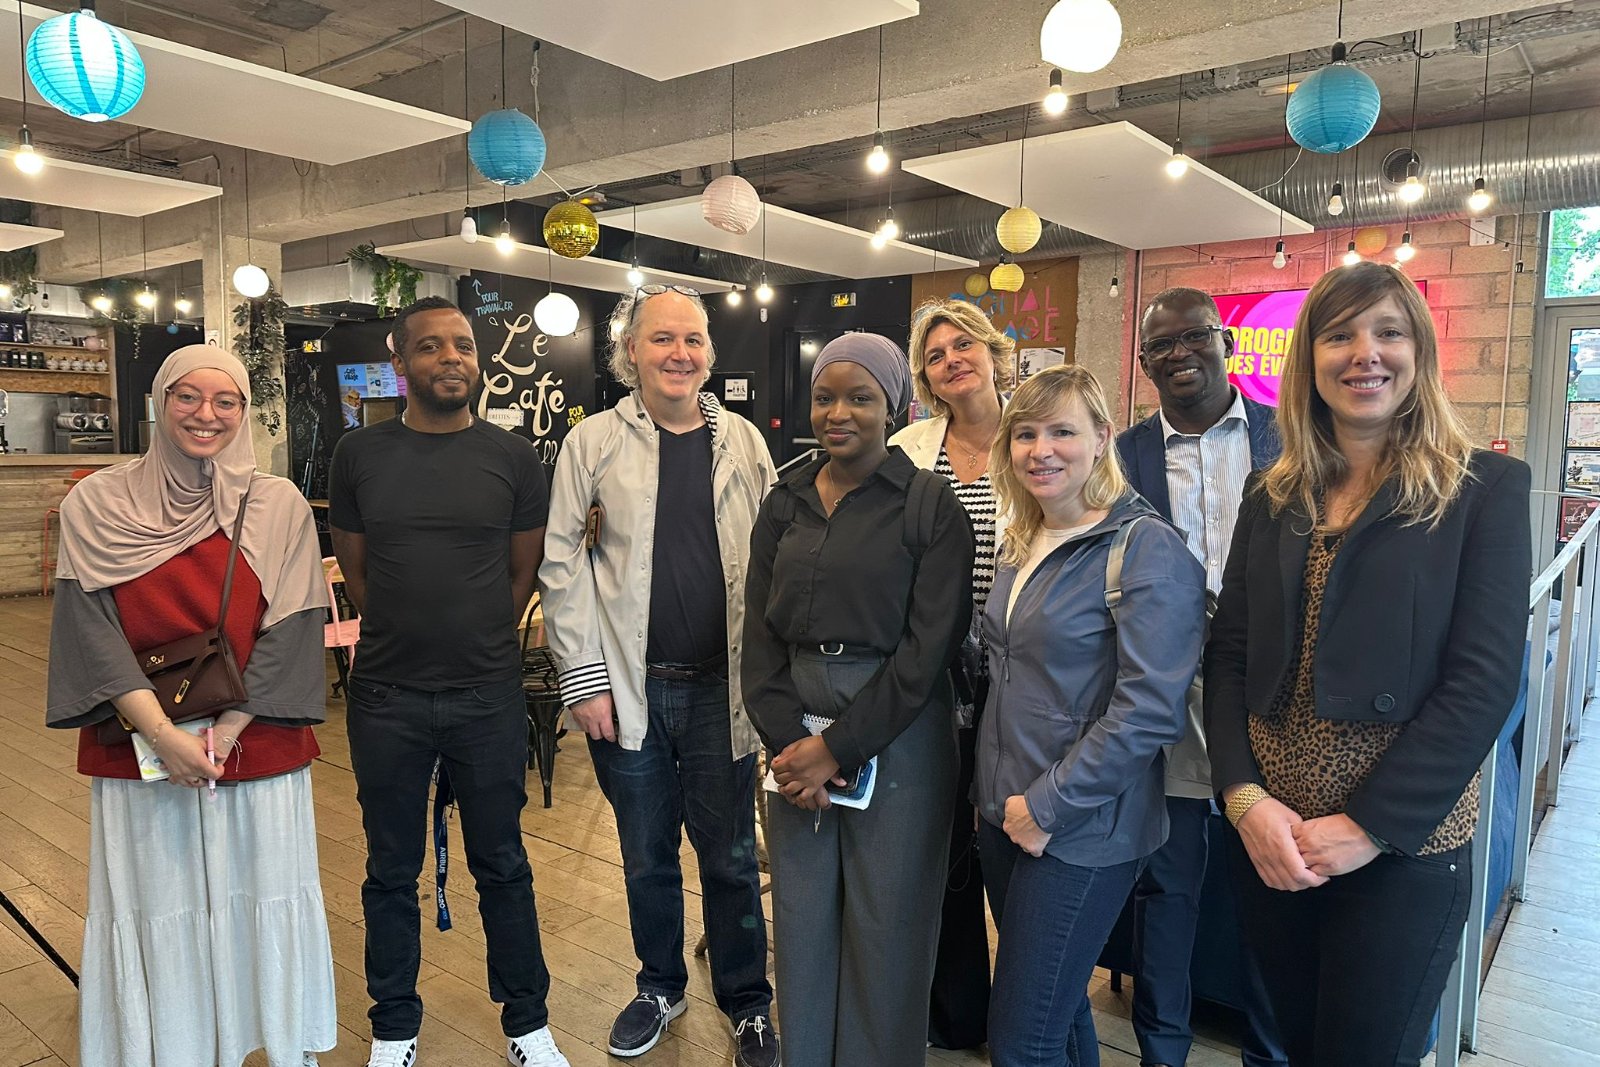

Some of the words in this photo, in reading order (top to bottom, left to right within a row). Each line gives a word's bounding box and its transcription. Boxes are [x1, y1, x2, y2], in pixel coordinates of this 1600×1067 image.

[481, 291, 499, 304] POUR
[491, 313, 550, 376] Le
[1224, 354, 1255, 375] DES
[1259, 350, 1287, 377] ÉV
[477, 370, 565, 437] Café
[568, 405, 585, 418] POUR
[438, 846, 447, 874] AIRBUS
